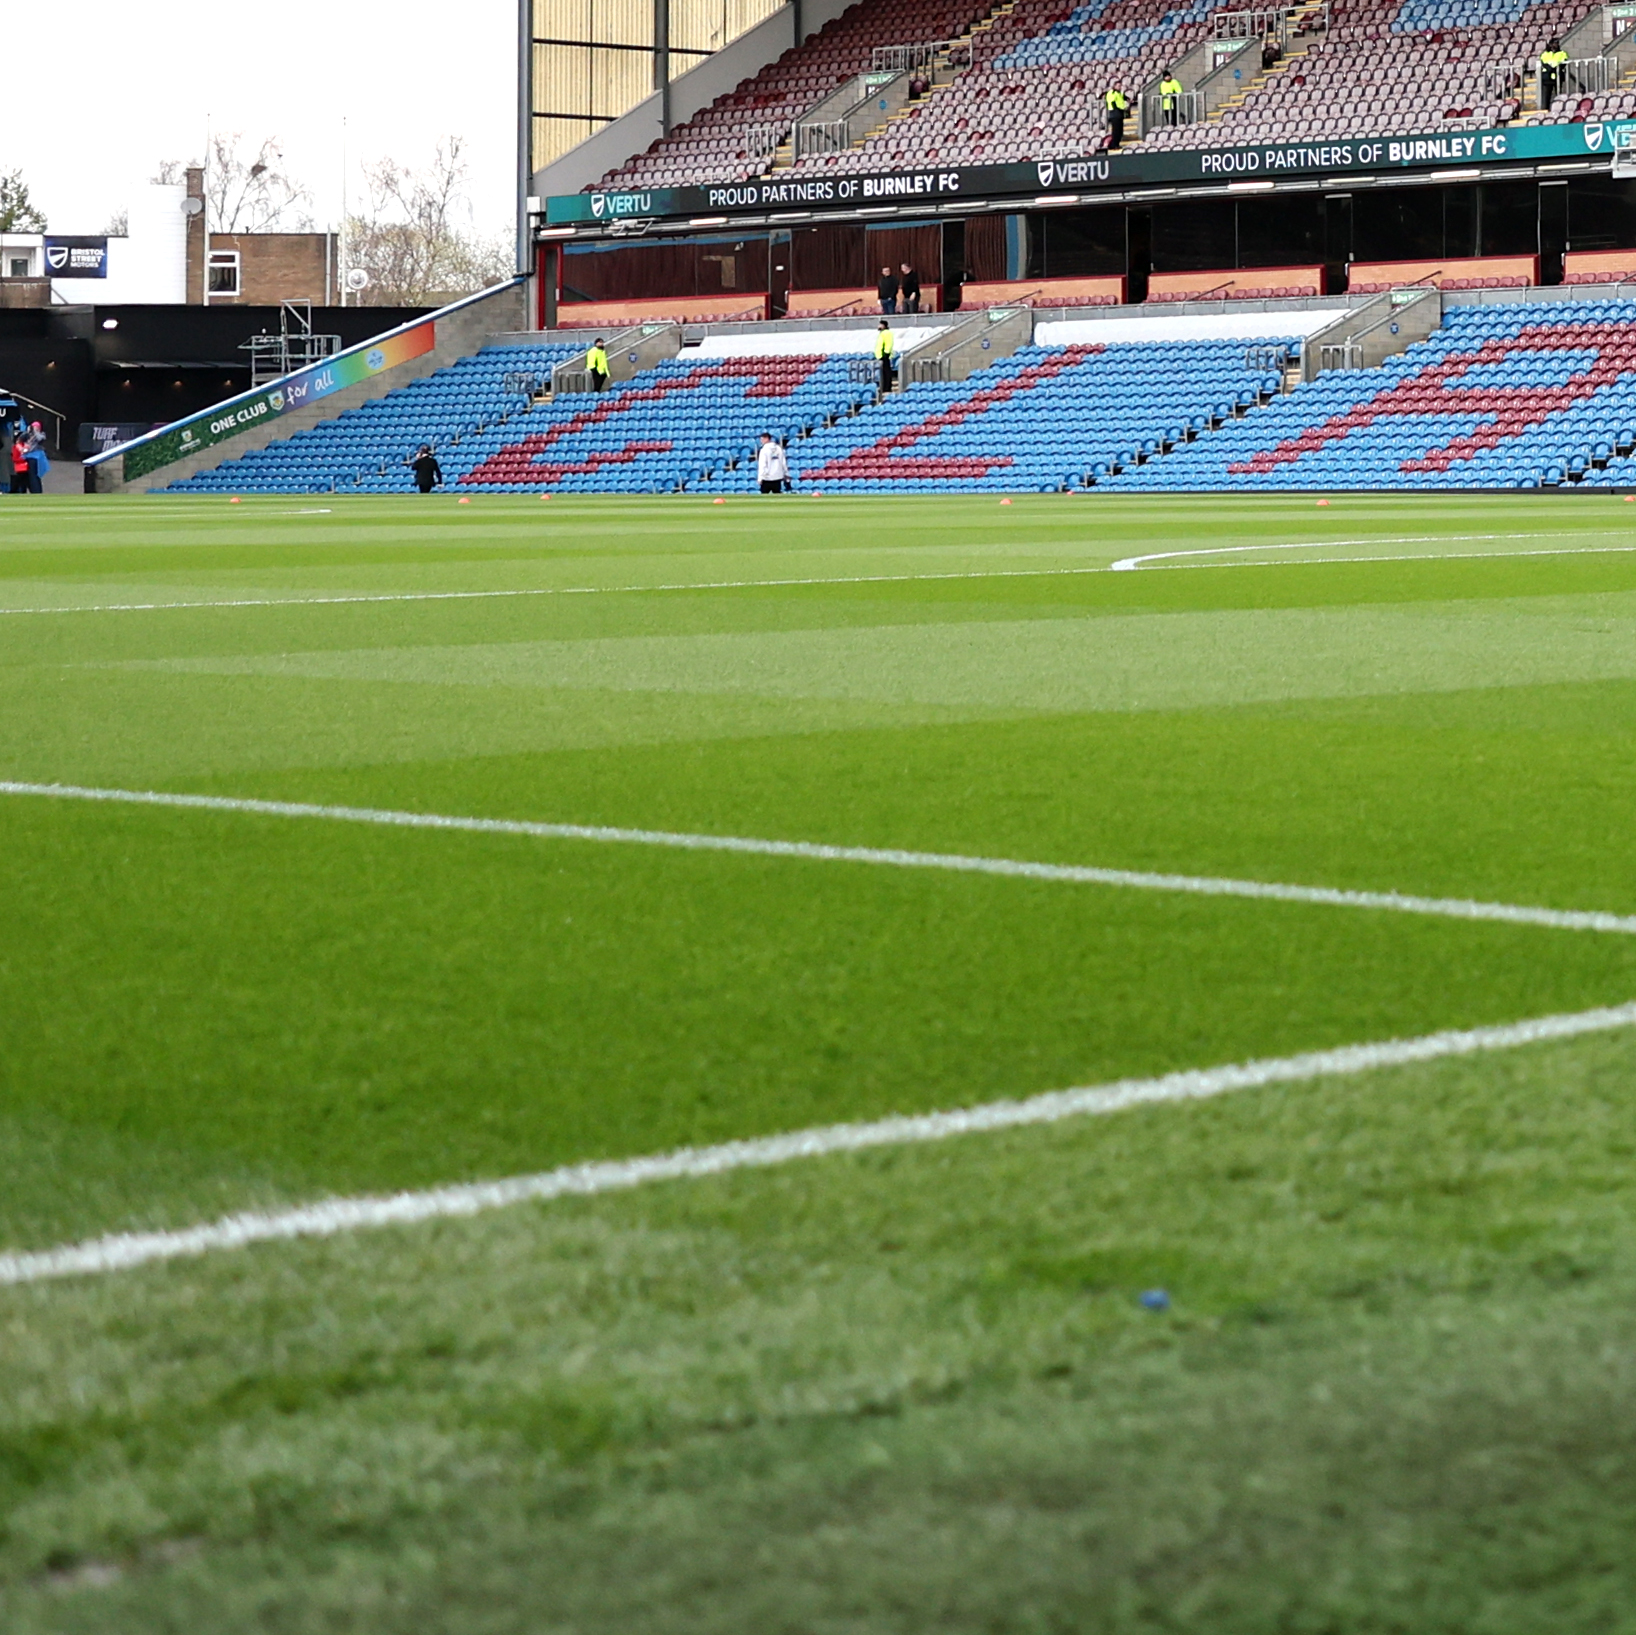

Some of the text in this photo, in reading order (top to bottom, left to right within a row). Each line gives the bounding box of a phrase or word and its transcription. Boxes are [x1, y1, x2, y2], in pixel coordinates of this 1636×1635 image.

[1202, 135, 1506, 173] PROUD PARTNERS OF BURNLEY FC
[709, 172, 959, 207] PROUD PARTNERS OF BURNLEY FC
[1056, 161, 1109, 183] VERTU
[606, 193, 651, 214] VERTU
[210, 369, 334, 434] ONE CLUB for all
